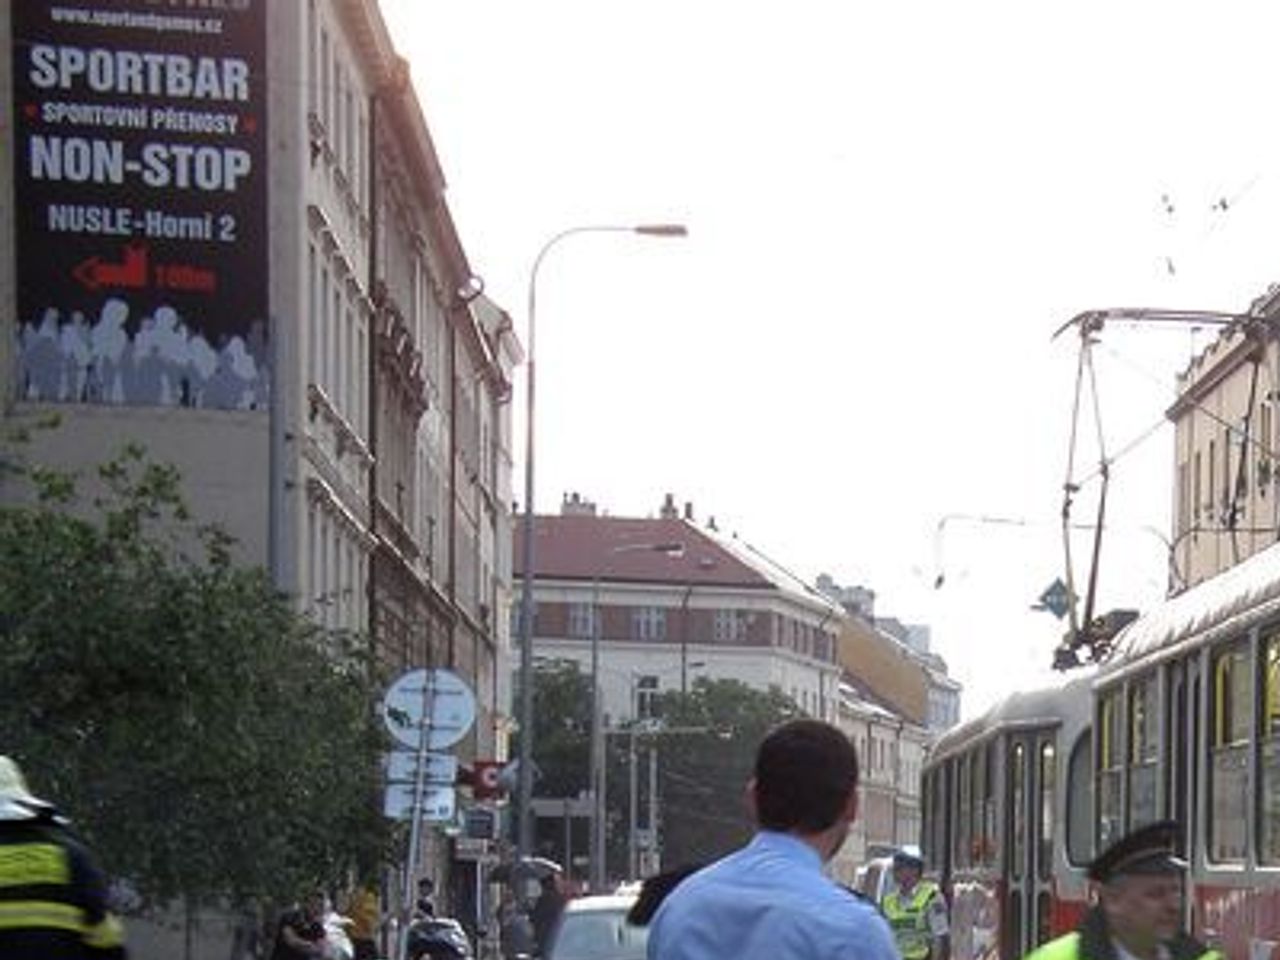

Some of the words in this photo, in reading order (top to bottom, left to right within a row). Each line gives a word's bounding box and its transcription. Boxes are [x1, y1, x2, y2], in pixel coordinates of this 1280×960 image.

[29, 45, 249, 100] SPORTBAR
[30, 135, 251, 191] NON-STOP
[219, 214, 236, 241] 2
